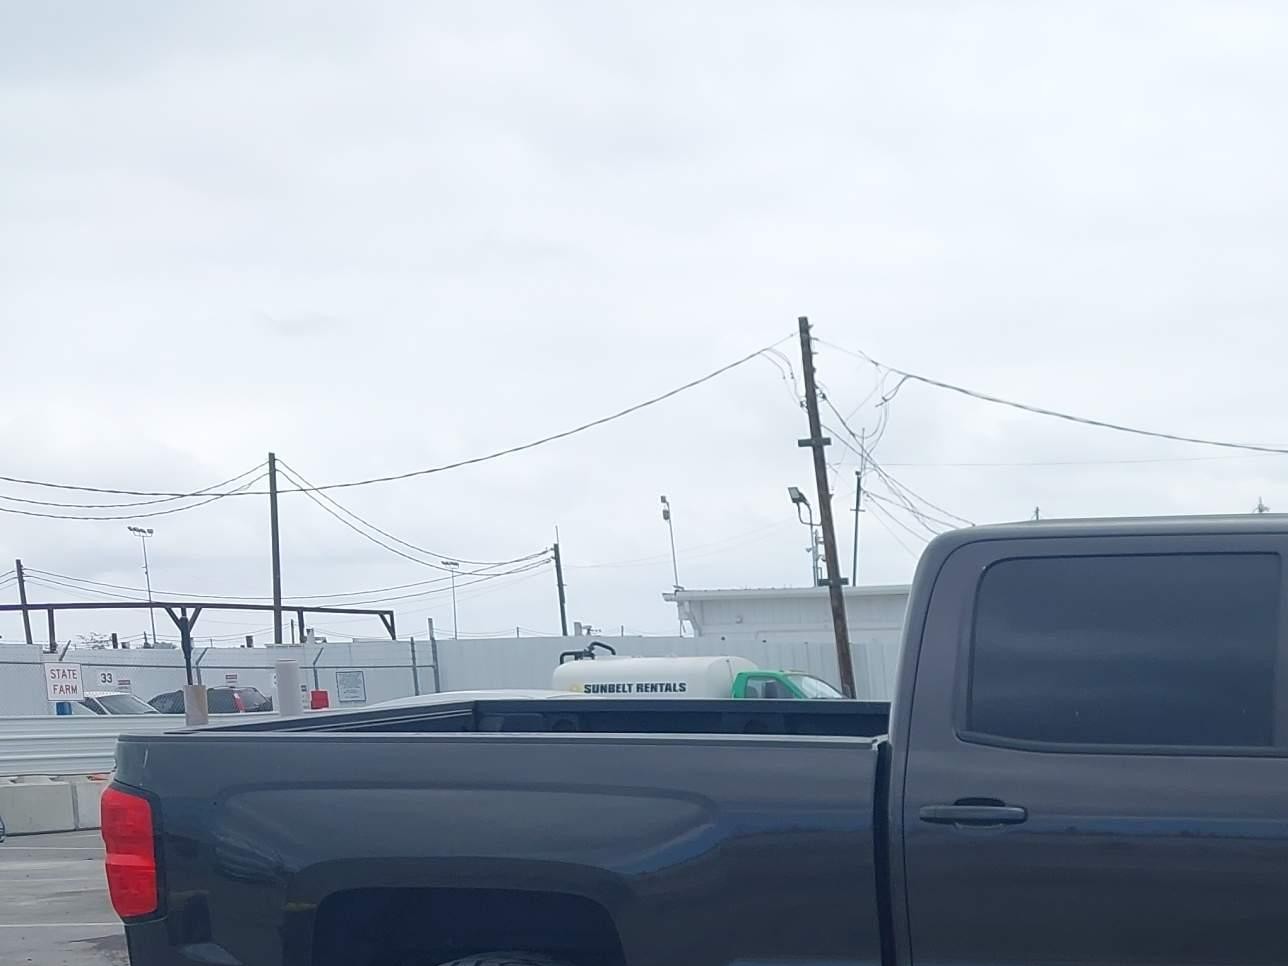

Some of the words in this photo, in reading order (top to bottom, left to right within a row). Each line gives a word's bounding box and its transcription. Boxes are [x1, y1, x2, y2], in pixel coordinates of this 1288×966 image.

[50, 668, 78, 680] STATE
[100, 672, 113, 684] 33
[52, 684, 78, 695] FARM
[583, 682, 634, 694] SUNBELT
[636, 682, 687, 693] RENTALS
